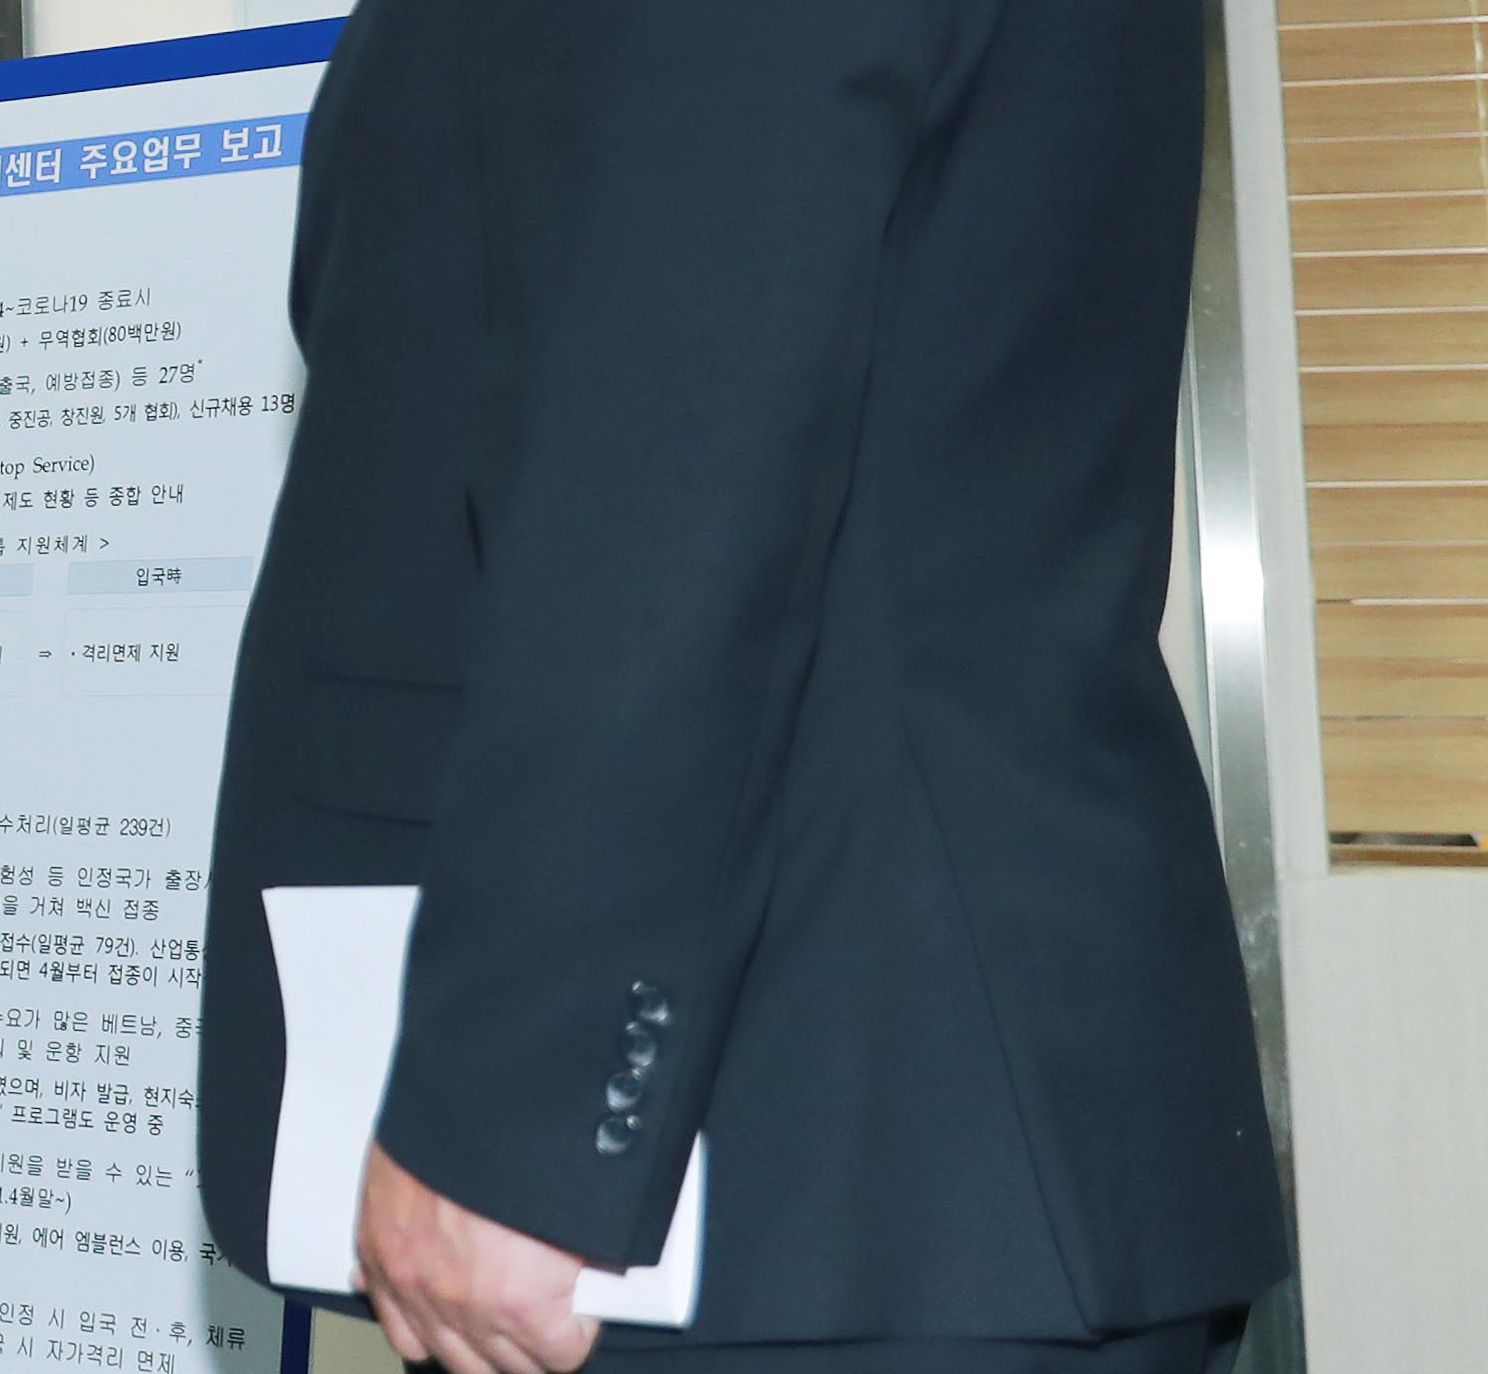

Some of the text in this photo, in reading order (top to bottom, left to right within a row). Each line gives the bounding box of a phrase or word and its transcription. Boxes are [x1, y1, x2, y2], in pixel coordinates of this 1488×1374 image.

[80, 133, 201, 179] 주요업무
[220, 124, 282, 163] 보고
[95, 287, 151, 311] 종료시
[130, 365, 150, 387] 등
[111, 403, 137, 423] 5개
[188, 395, 257, 419] 신규채용
[260, 392, 296, 415] 13명
[1, 490, 36, 511] 제도
[43, 488, 78, 510] 현황
[81, 487, 103, 508] 등
[106, 485, 145, 507] 종합
[148, 483, 184, 505] 안내
[16, 534, 88, 556] 지원체계
[81, 642, 180, 664] 격리면제 지원
[46, 866, 67, 888] 등
[77, 866, 152, 891] 인정국가
[164, 868, 212, 892] 출장
[28, 894, 68, 918] 거쳐
[76, 895, 112, 920] 백신
[122, 897, 160, 922] 접종
[53, 1010, 90, 1033] 많은
[14, 1038, 34, 1062] 및
[45, 1040, 83, 1064] 운항
[93, 1041, 131, 1067] 지원
[53, 1157, 93, 1182] 받을
[104, 1161, 124, 1183] 수
[135, 1163, 173, 1188] 있는
[47, 1307, 65, 1331] 시
[79, 1310, 117, 1337] 입국
[205, 1324, 246, 1351] 체류
